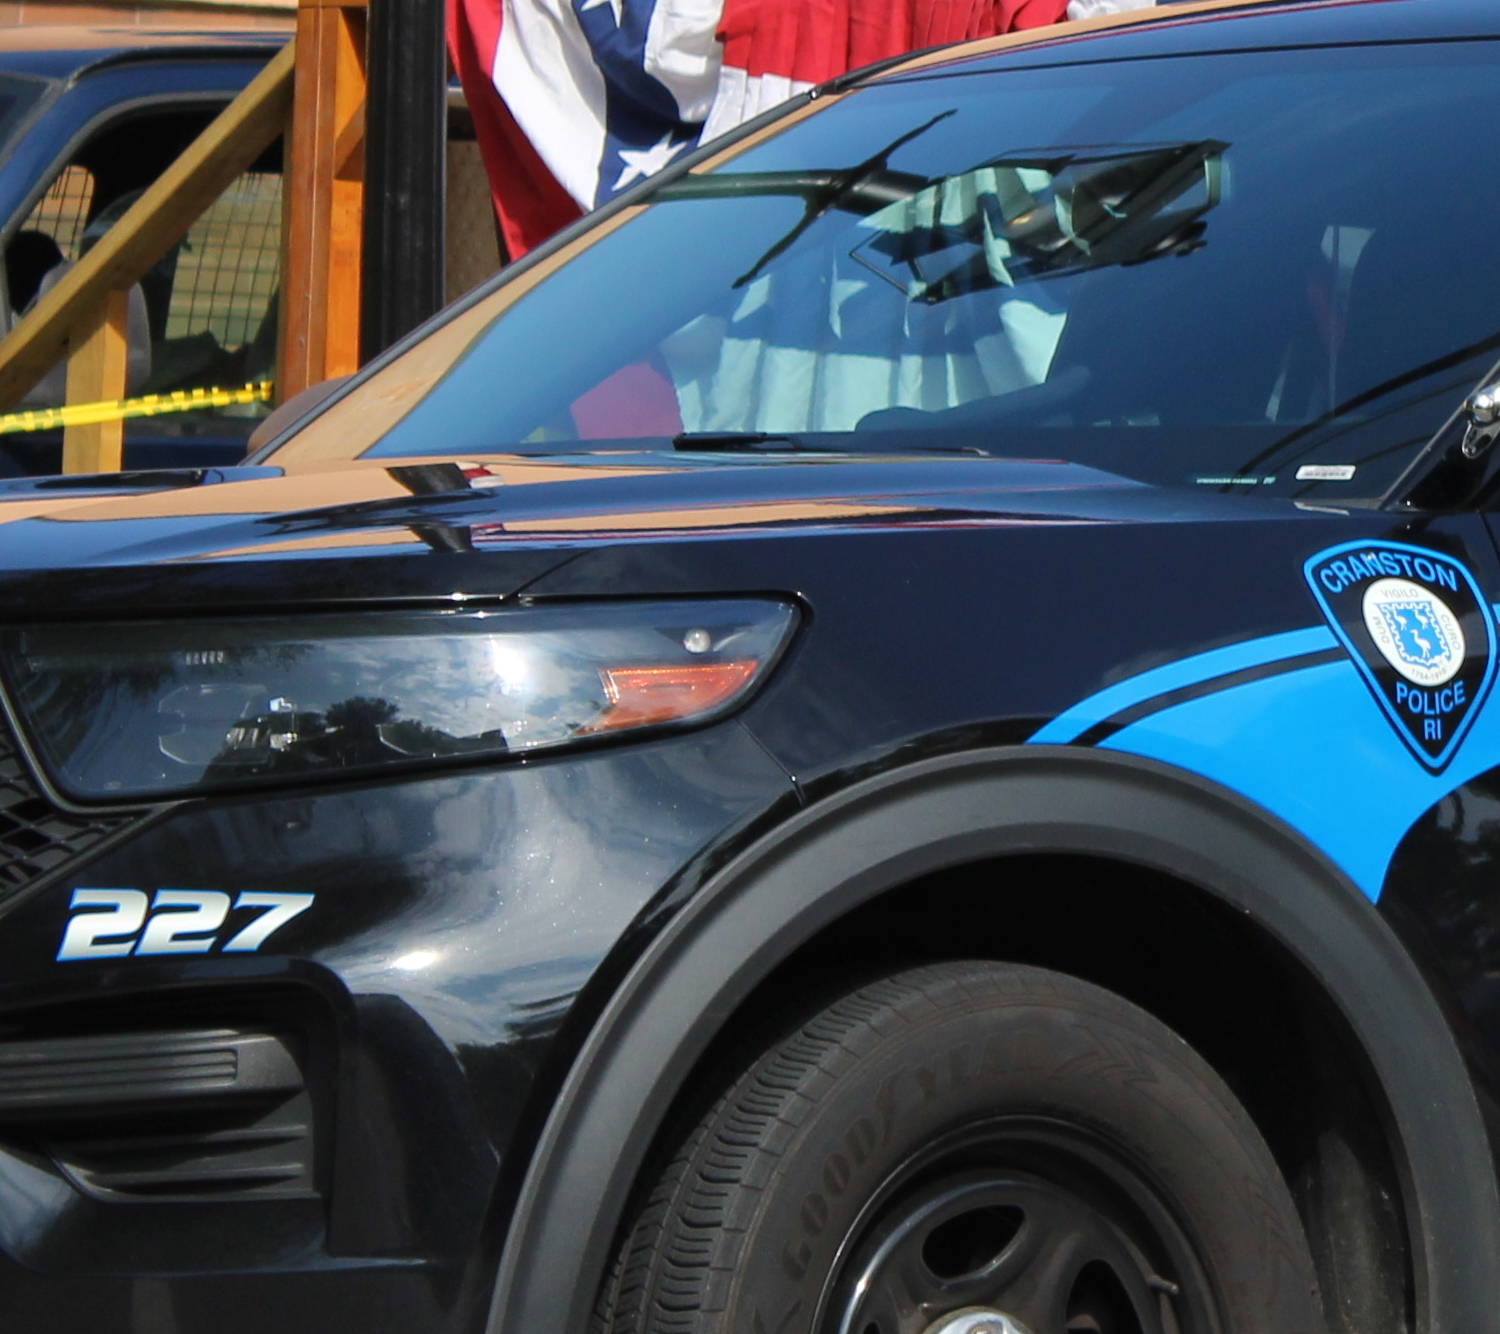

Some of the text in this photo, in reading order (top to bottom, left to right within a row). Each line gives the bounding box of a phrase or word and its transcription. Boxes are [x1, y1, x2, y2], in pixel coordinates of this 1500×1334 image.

[1320, 552, 1459, 595] CRANSTON
[1380, 587, 1419, 599] VIGILO
[1440, 613, 1461, 652] CURO
[1396, 680, 1467, 716] POLICE
[1423, 718, 1443, 740] RI
[56, 886, 316, 964] 227
